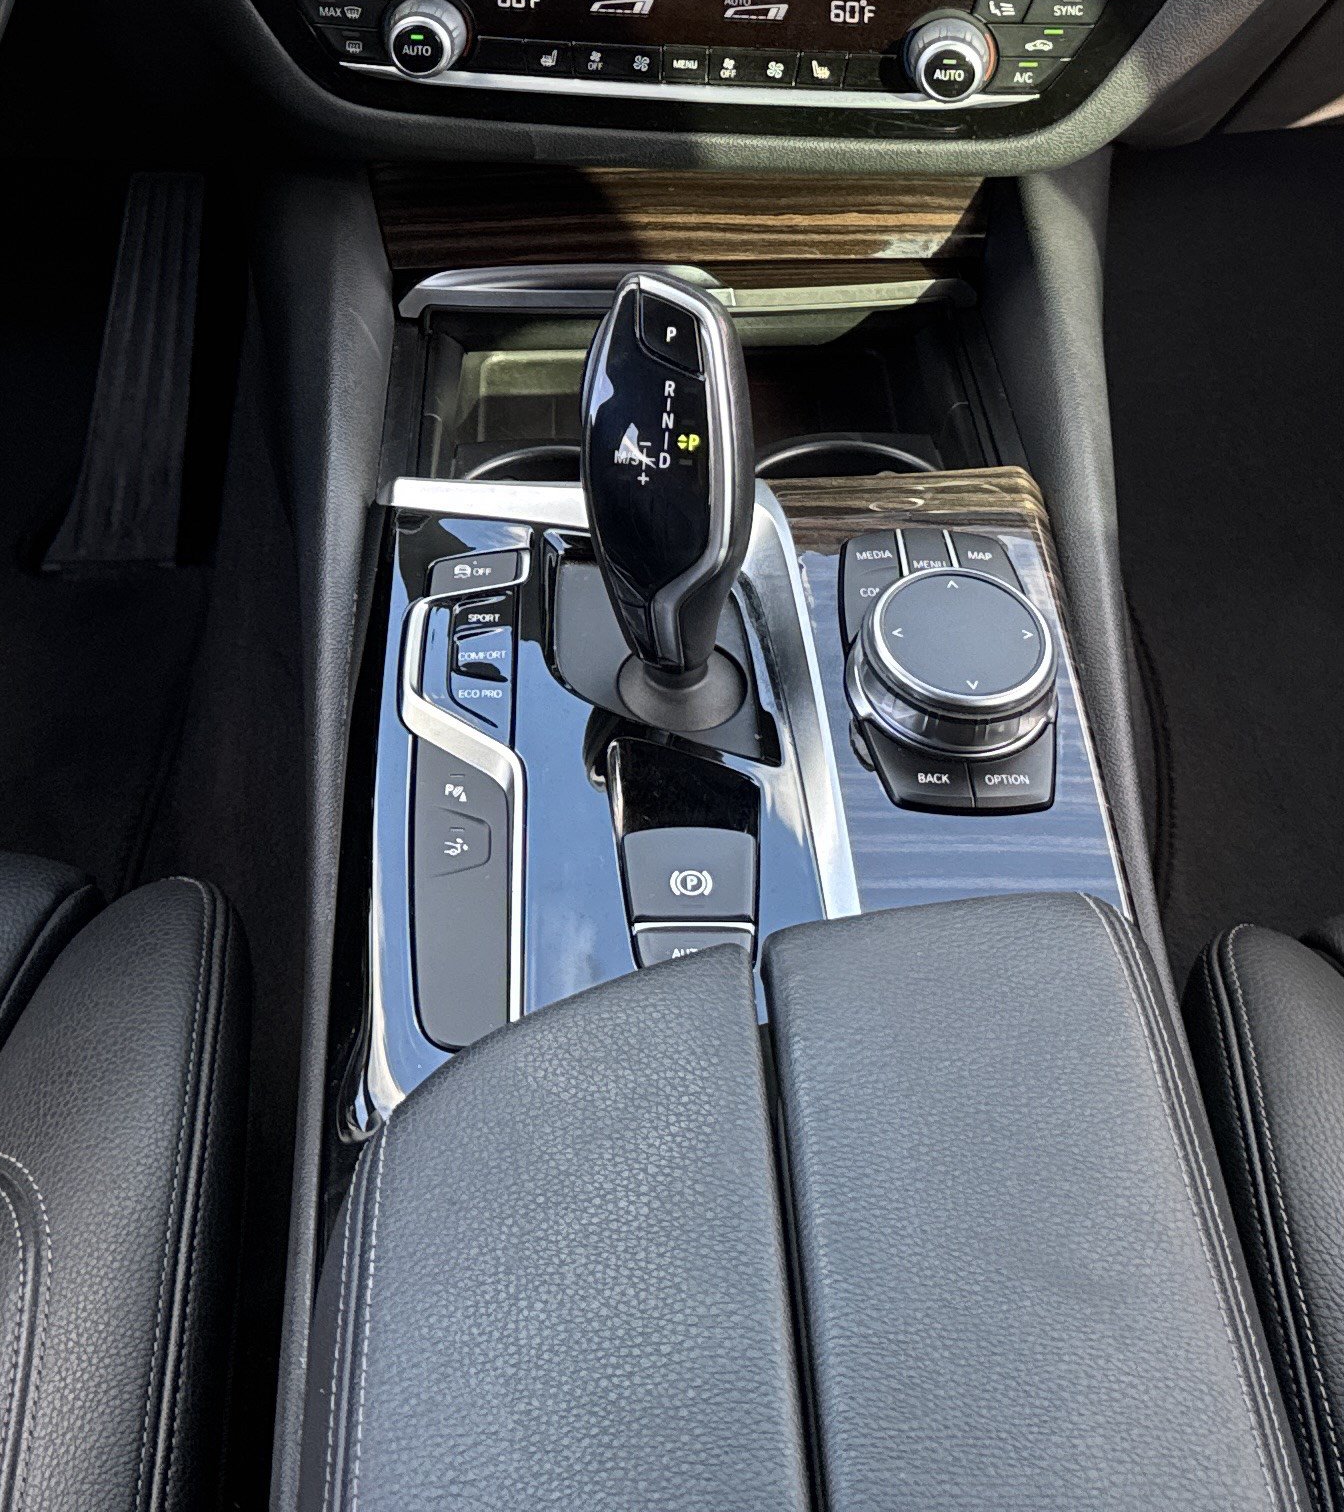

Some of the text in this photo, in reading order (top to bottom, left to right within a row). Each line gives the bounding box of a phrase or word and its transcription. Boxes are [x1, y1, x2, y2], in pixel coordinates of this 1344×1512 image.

[319, 5, 342, 19] MAX
[1053, 4, 1083, 18] SYNC
[402, 44, 432, 58] AUTO
[587, 62, 603, 71] OFF
[673, 59, 698, 70] MENU
[720, 69, 736, 78] OFF
[933, 68, 964, 82] AUTO
[1013, 71, 1033, 85] A/C
[666, 326, 677, 343] P
[664, 380, 676, 397] R
[661, 412, 675, 429] N
[658, 452, 671, 469] D
[856, 549, 893, 561] MEDIA
[967, 551, 993, 561] MAP
[472, 567, 492, 577] OFF
[859, 587, 880, 598] CO
[467, 613, 501, 623] SPORT
[458, 650, 506, 661] COMFORT
[458, 689, 502, 699] ECO PRO
[917, 772, 950, 786] BACK
[984, 772, 1030, 787] OPTION
